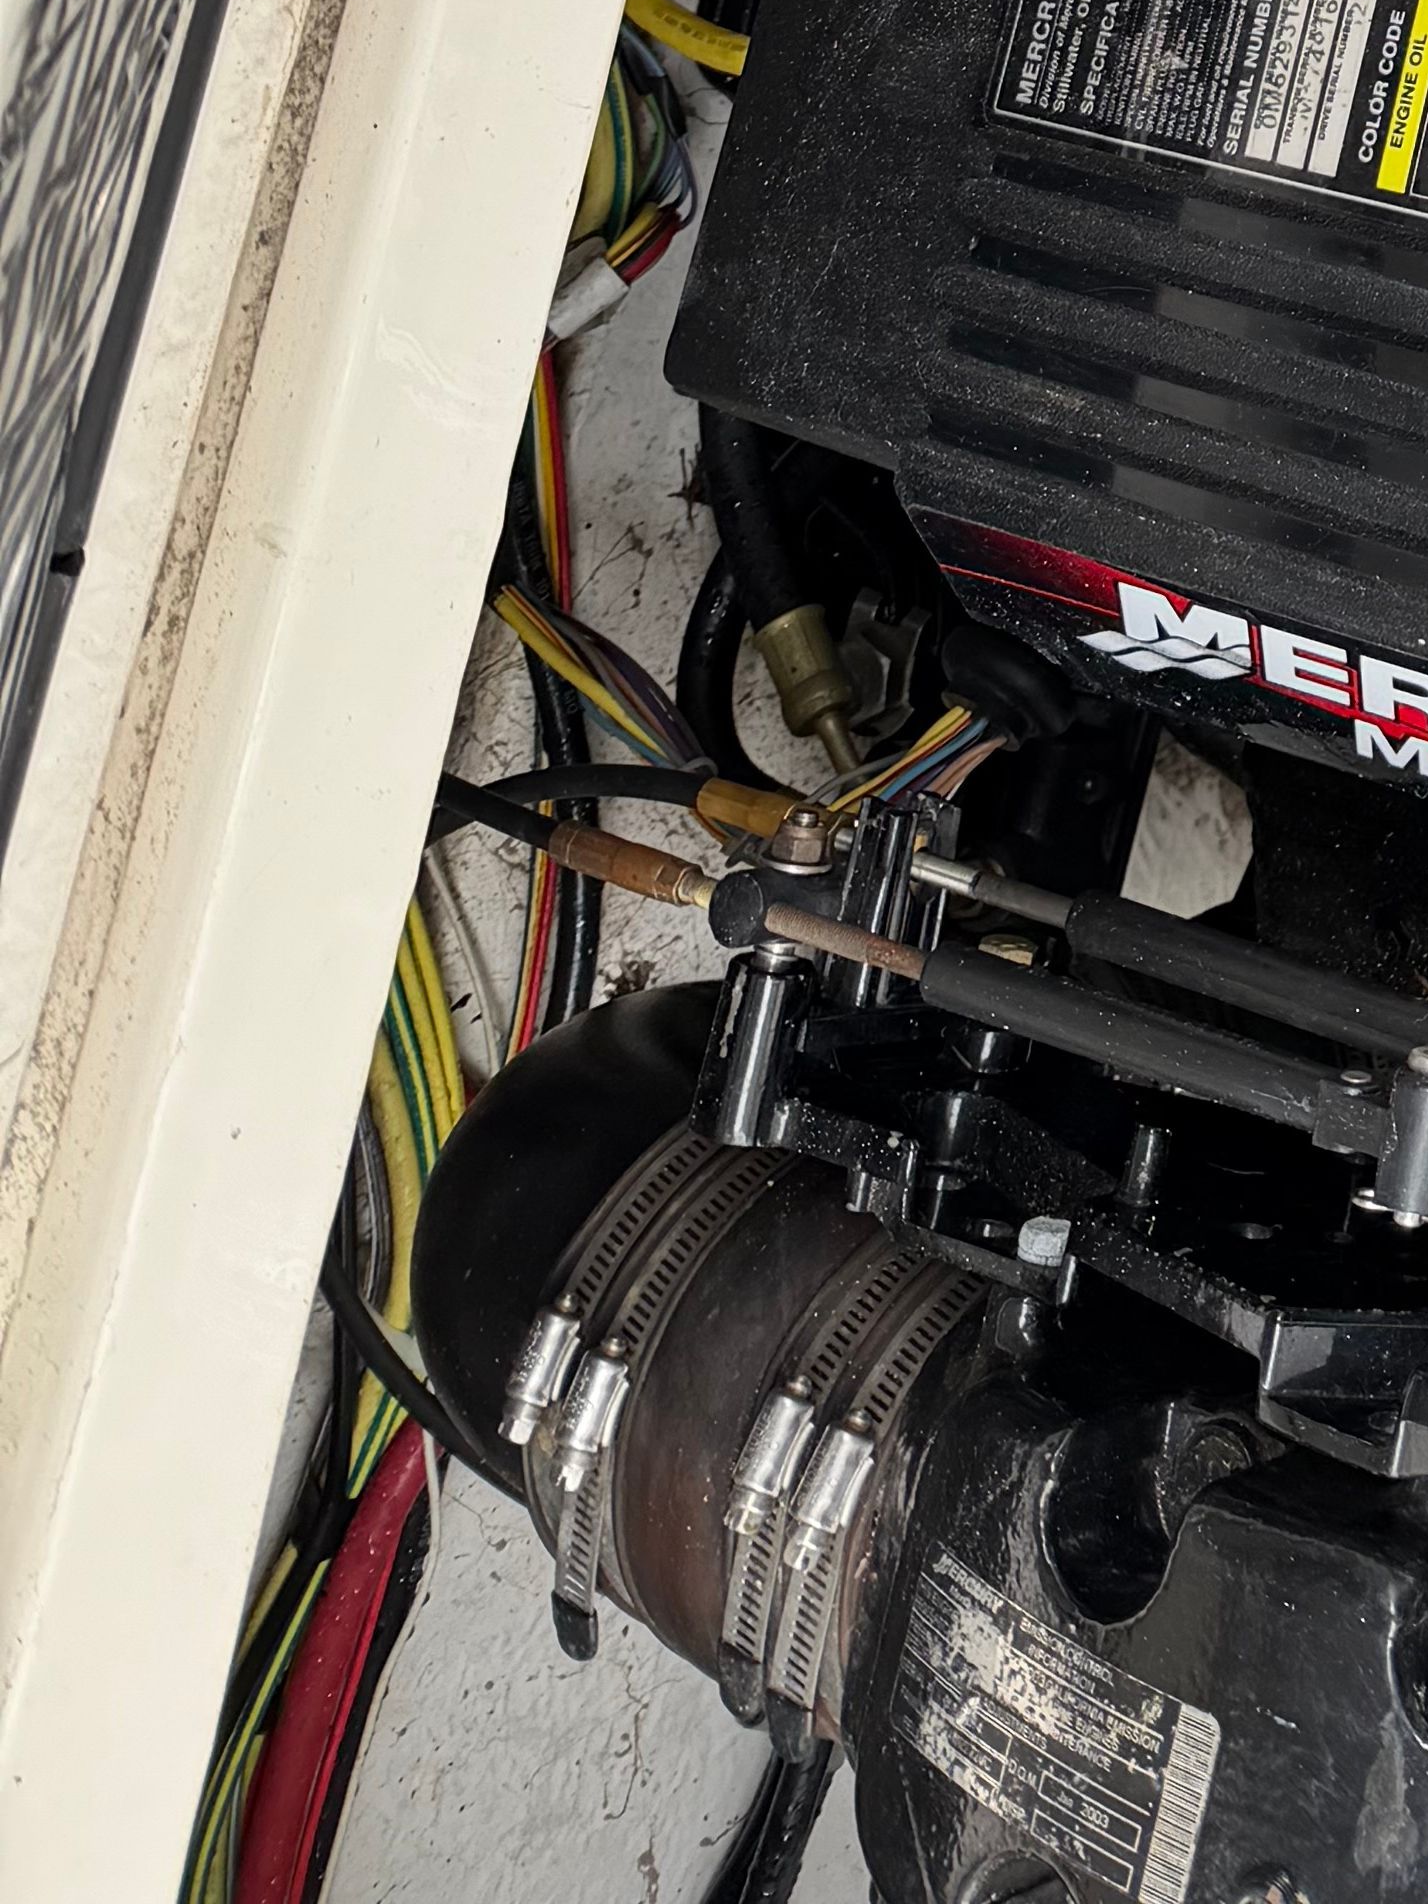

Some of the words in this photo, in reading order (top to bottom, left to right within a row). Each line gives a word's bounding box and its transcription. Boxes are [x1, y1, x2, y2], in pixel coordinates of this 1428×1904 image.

[1037, 48, 1062, 109] Division
[1053, 30, 1067, 47] of
[1052, 20, 1087, 113] Stillwater,
[1113, 73, 1133, 125] IGNITION
[1126, 31, 1143, 71] TIMING
[1206, 80, 1218, 103] and
[1356, 79, 1389, 164] COLOR
[1377, 8, 1405, 76] CODE
[1389, 70, 1419, 149] ENGINE
[1407, 31, 1428, 67] OIL
[1184, 109, 1199, 142] PLUG
[1222, 71, 1255, 156] SERIAL
[931, 1553, 1004, 1613] MERCURY
[1075, 1803, 1113, 1830] 2003
